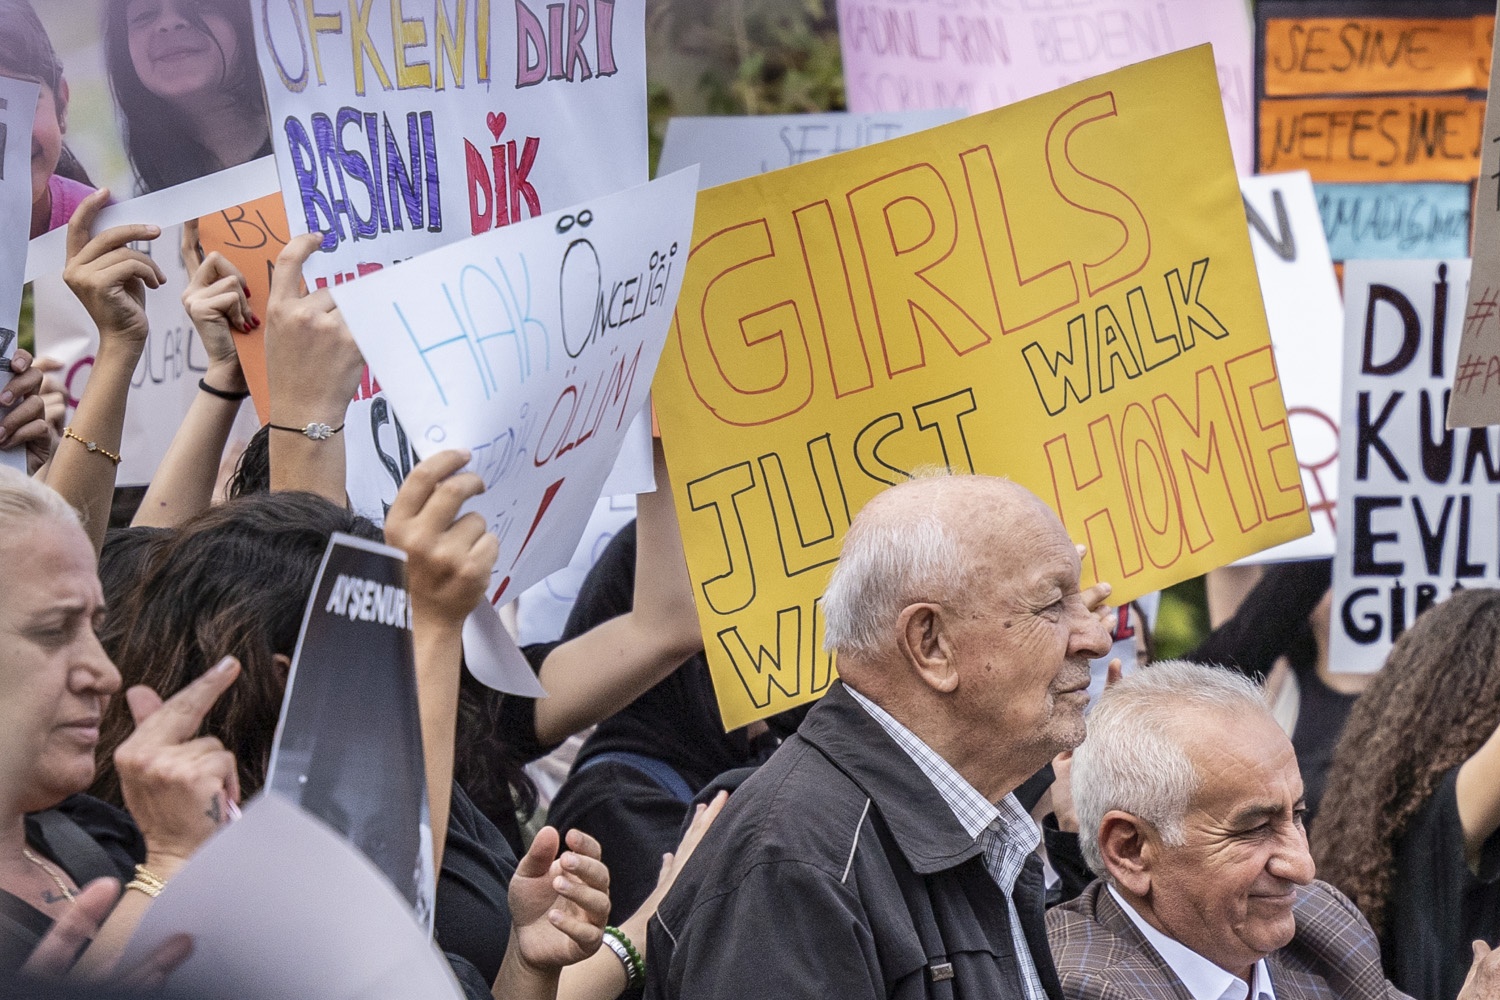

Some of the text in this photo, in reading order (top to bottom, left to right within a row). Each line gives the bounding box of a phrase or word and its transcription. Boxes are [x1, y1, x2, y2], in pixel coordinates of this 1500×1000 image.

[393, 252, 551, 406] HAK
[676, 91, 1152, 427] GIRLS
[1021, 258, 1229, 417] WALK
[1043, 345, 1304, 587] HOME
